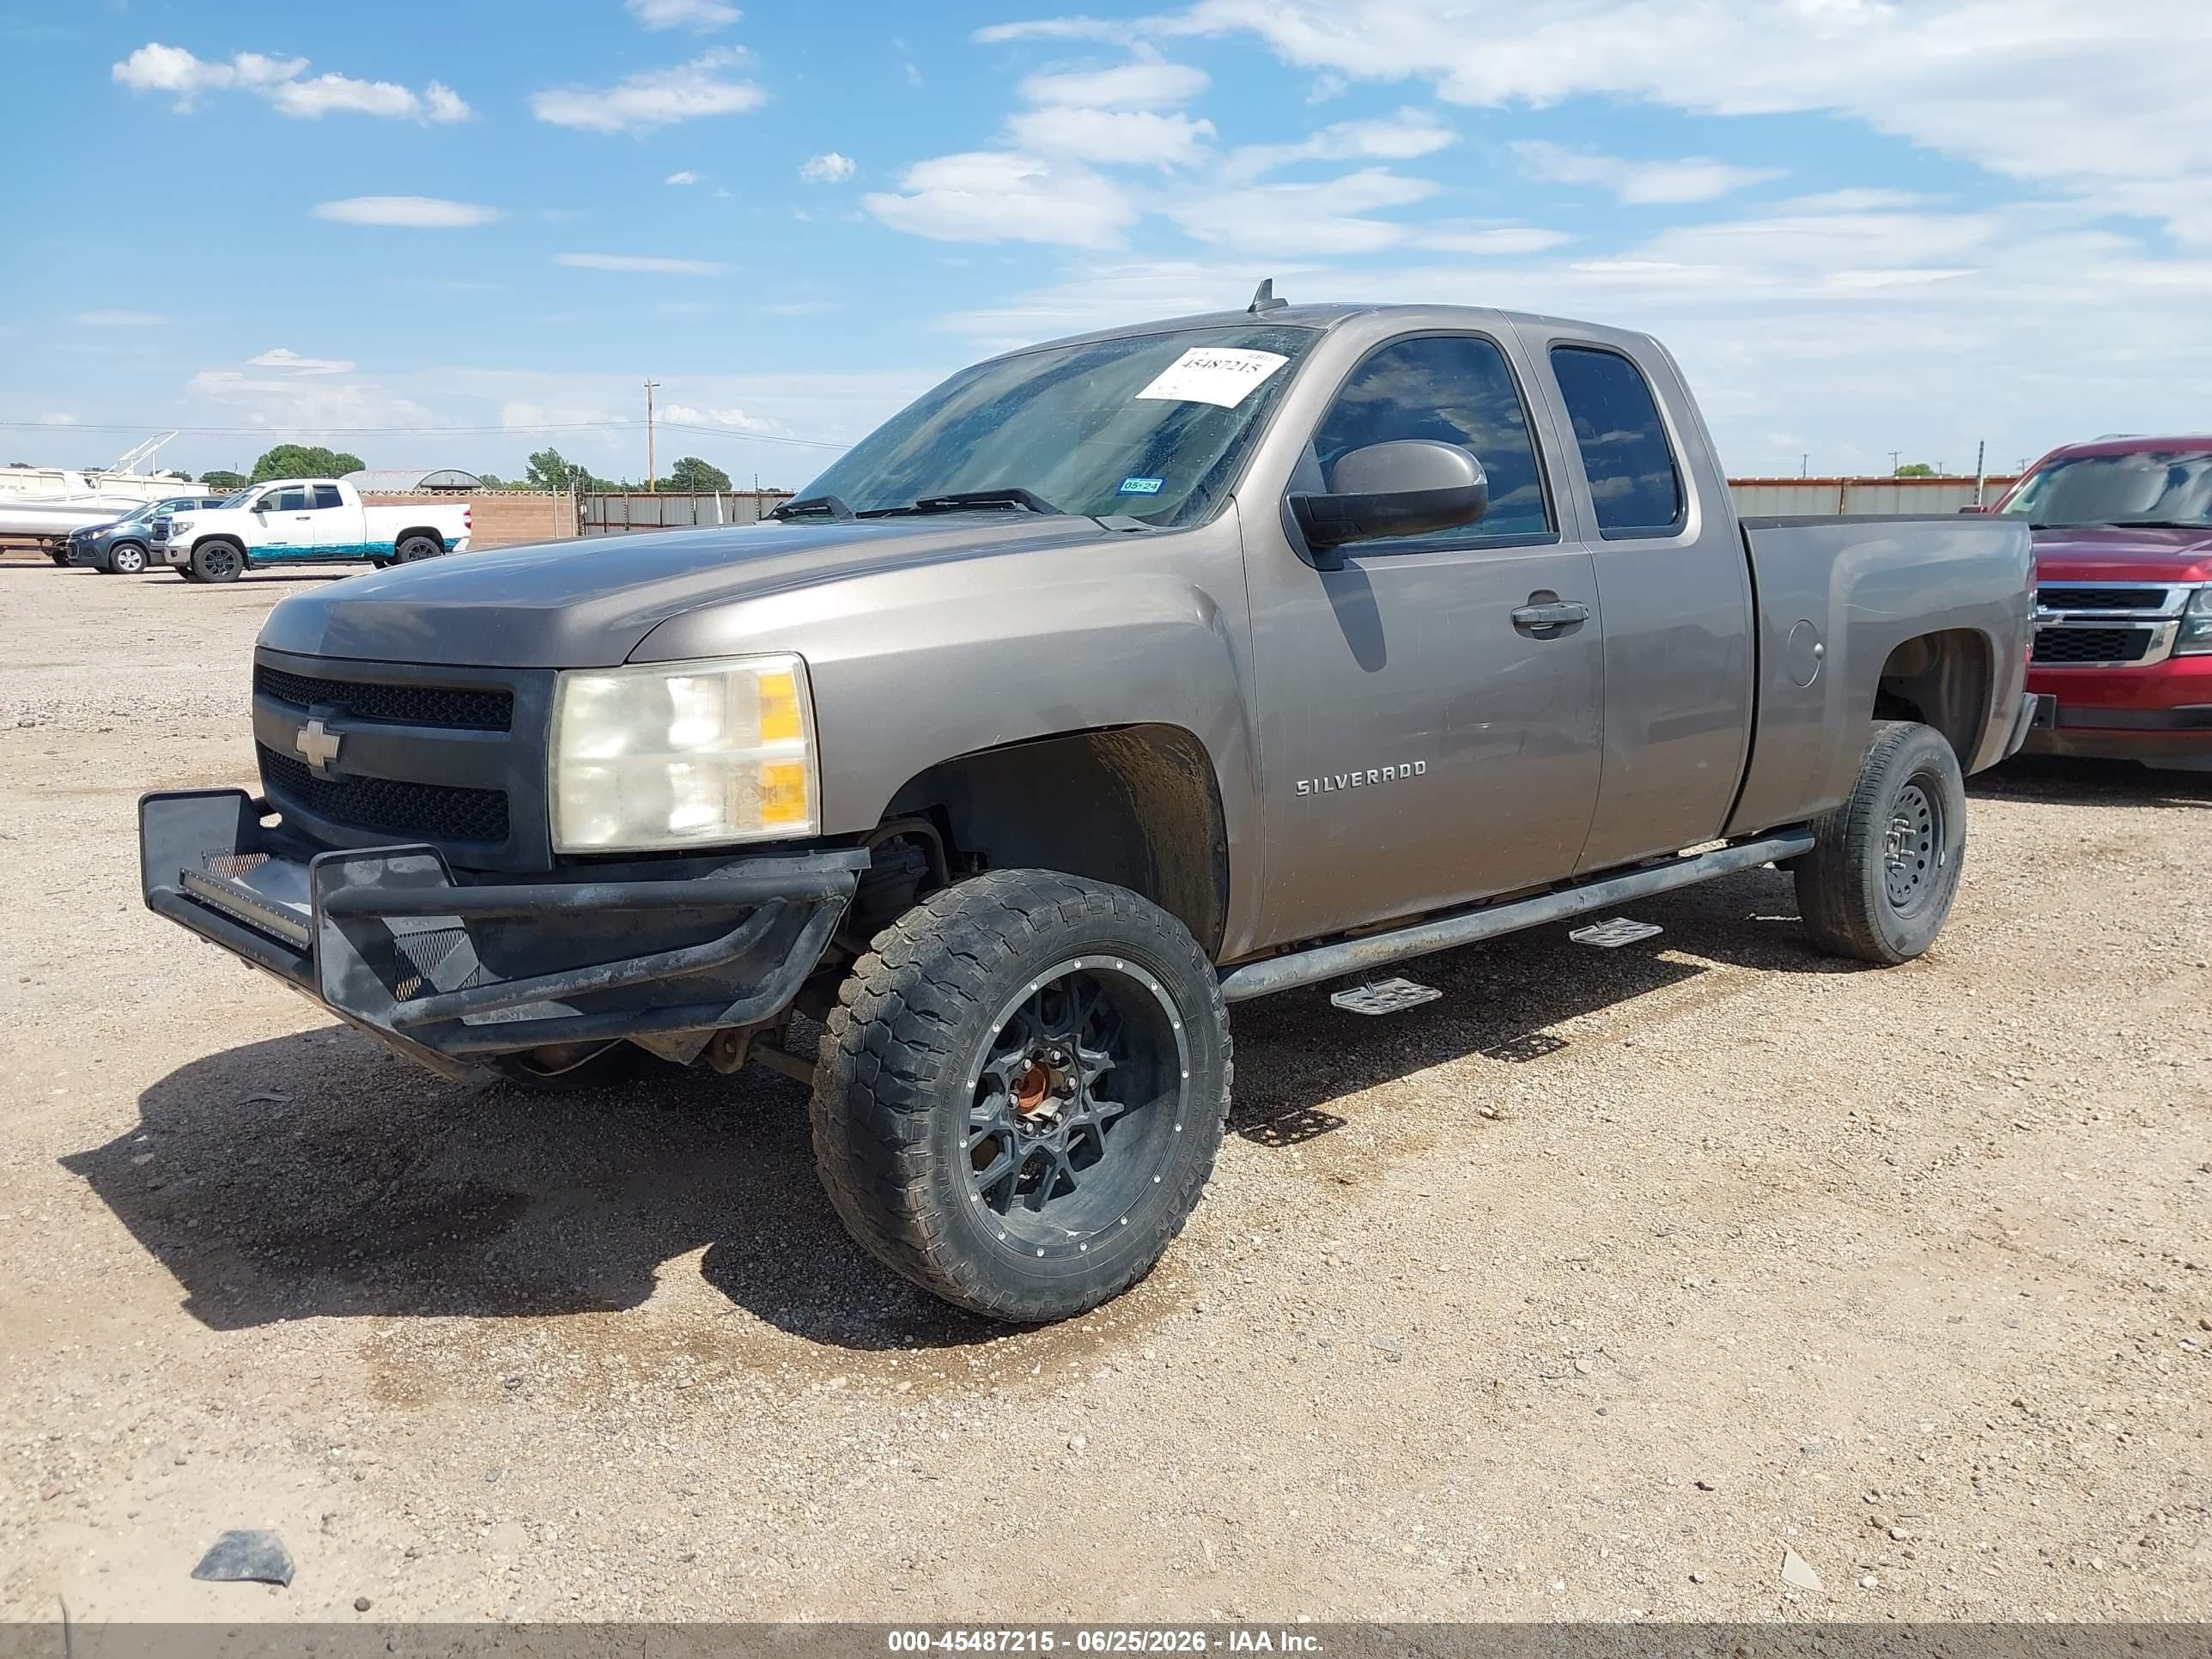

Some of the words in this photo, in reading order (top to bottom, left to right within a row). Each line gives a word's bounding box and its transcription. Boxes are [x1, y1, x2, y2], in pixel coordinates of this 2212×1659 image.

[1182, 357, 1263, 373] 45487215
[1295, 760, 1427, 798] SILVERADO
[1154, 1088, 1220, 1238] IRONMAN
